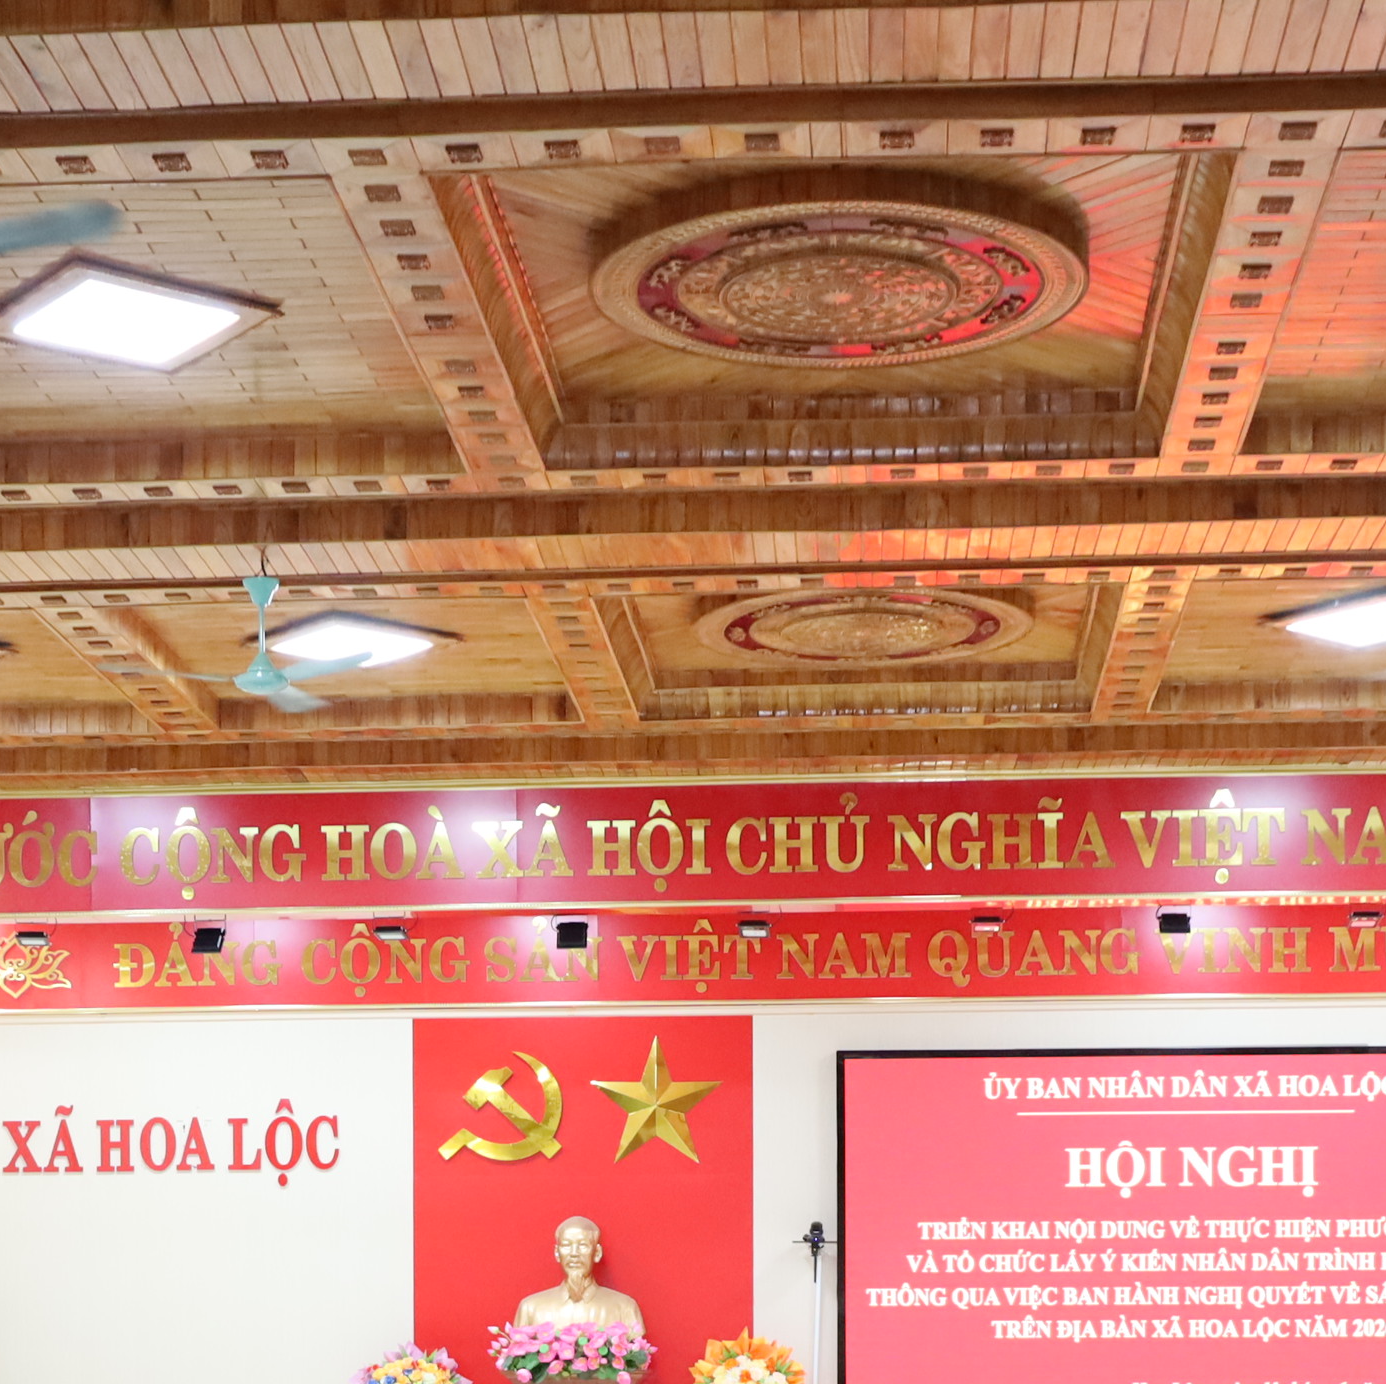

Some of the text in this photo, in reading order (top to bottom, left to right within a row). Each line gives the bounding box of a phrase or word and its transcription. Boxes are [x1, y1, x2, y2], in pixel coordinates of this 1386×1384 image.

[119, 806, 307, 900] CỘNG
[321, 805, 465, 881] HOÀ
[471, 803, 573, 879] XÃ
[586, 799, 711, 892] HỘI
[726, 792, 870, 875] CHỦ
[887, 797, 1115, 871] NGHĨA
[1121, 788, 1287, 884] VIỆT
[114, 923, 282, 987] ĐẢNG
[301, 922, 470, 997] CỘNG
[485, 916, 600, 983] SẢN
[617, 919, 761, 992] VIỆT
[777, 932, 911, 979] NAM
[928, 926, 1138, 987] QUANG
[1155, 928, 1311, 974] VINH
[984, 1072, 1021, 1099] ỦY
[1027, 1077, 1081, 1099] BAN
[1088, 1070, 1165, 1098] NHÂN
[1171, 1070, 1228, 1097] DÂN
[1234, 1070, 1272, 1097] XÃ
[1278, 1075, 1339, 1097] HOA
[3, 1099, 339, 1187] XÃ HOA LỘC
[1065, 1141, 1318, 1198] HỘI NGHỊ
[992, 1221, 1049, 1239] KHAI
[1054, 1219, 1096, 1243] NỘI
[1101, 1220, 1165, 1239] DUNG
[1204, 1217, 1269, 1242] THỰC
[1275, 1217, 1331, 1242] HIỆN
[906, 1250, 938, 1272] VÀ
[979, 1249, 1045, 1272] CHỨC
[1100, 1249, 1116, 1271] Ý
[1182, 1248, 1246, 1271] NHÂN
[1251, 1247, 1299, 1271] DÂN
[1303, 1247, 1375, 1271] TRÌNH
[866, 1283, 947, 1306] THÔNG
[952, 1288, 1000, 1309] QUA
[1003, 1285, 1058, 1310] VIỆC
[1063, 1287, 1109, 1305] BAN
[1114, 1282, 1179, 1305] HÀNH
[1184, 1286, 1243, 1309] NGHỊ
[991, 1315, 1052, 1338] TRÊN
[1057, 1320, 1097, 1343] ĐỊA
[1101, 1315, 1147, 1338] BÀN
[1152, 1316, 1184, 1338] XÃ
[1189, 1319, 1239, 1338] HOA
[1242, 1317, 1290, 1342] LỘC
[1295, 1315, 1348, 1337] NĂM
